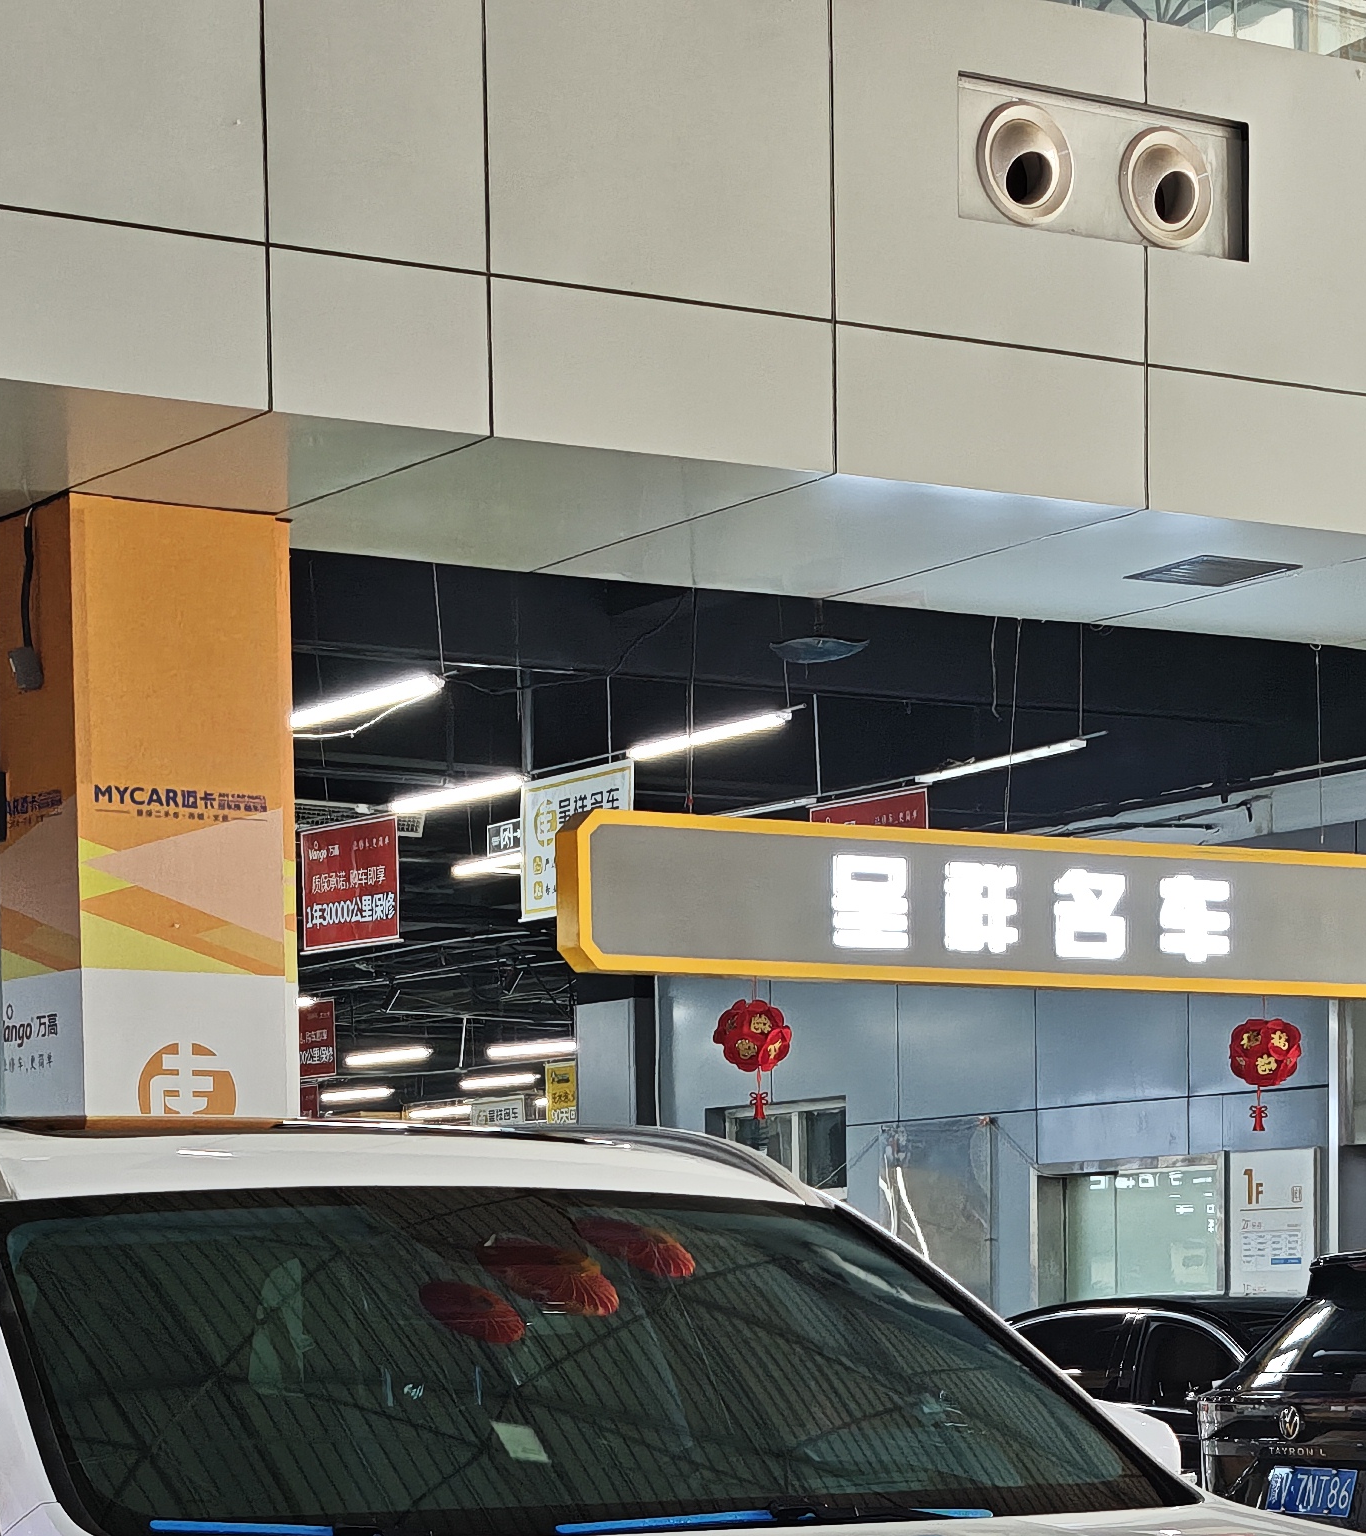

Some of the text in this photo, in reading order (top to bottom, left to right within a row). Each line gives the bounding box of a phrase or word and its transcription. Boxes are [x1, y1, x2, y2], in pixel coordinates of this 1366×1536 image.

[1242, 1168, 1264, 1205] 1F
[1268, 1446, 1327, 1456] TAYRON L
